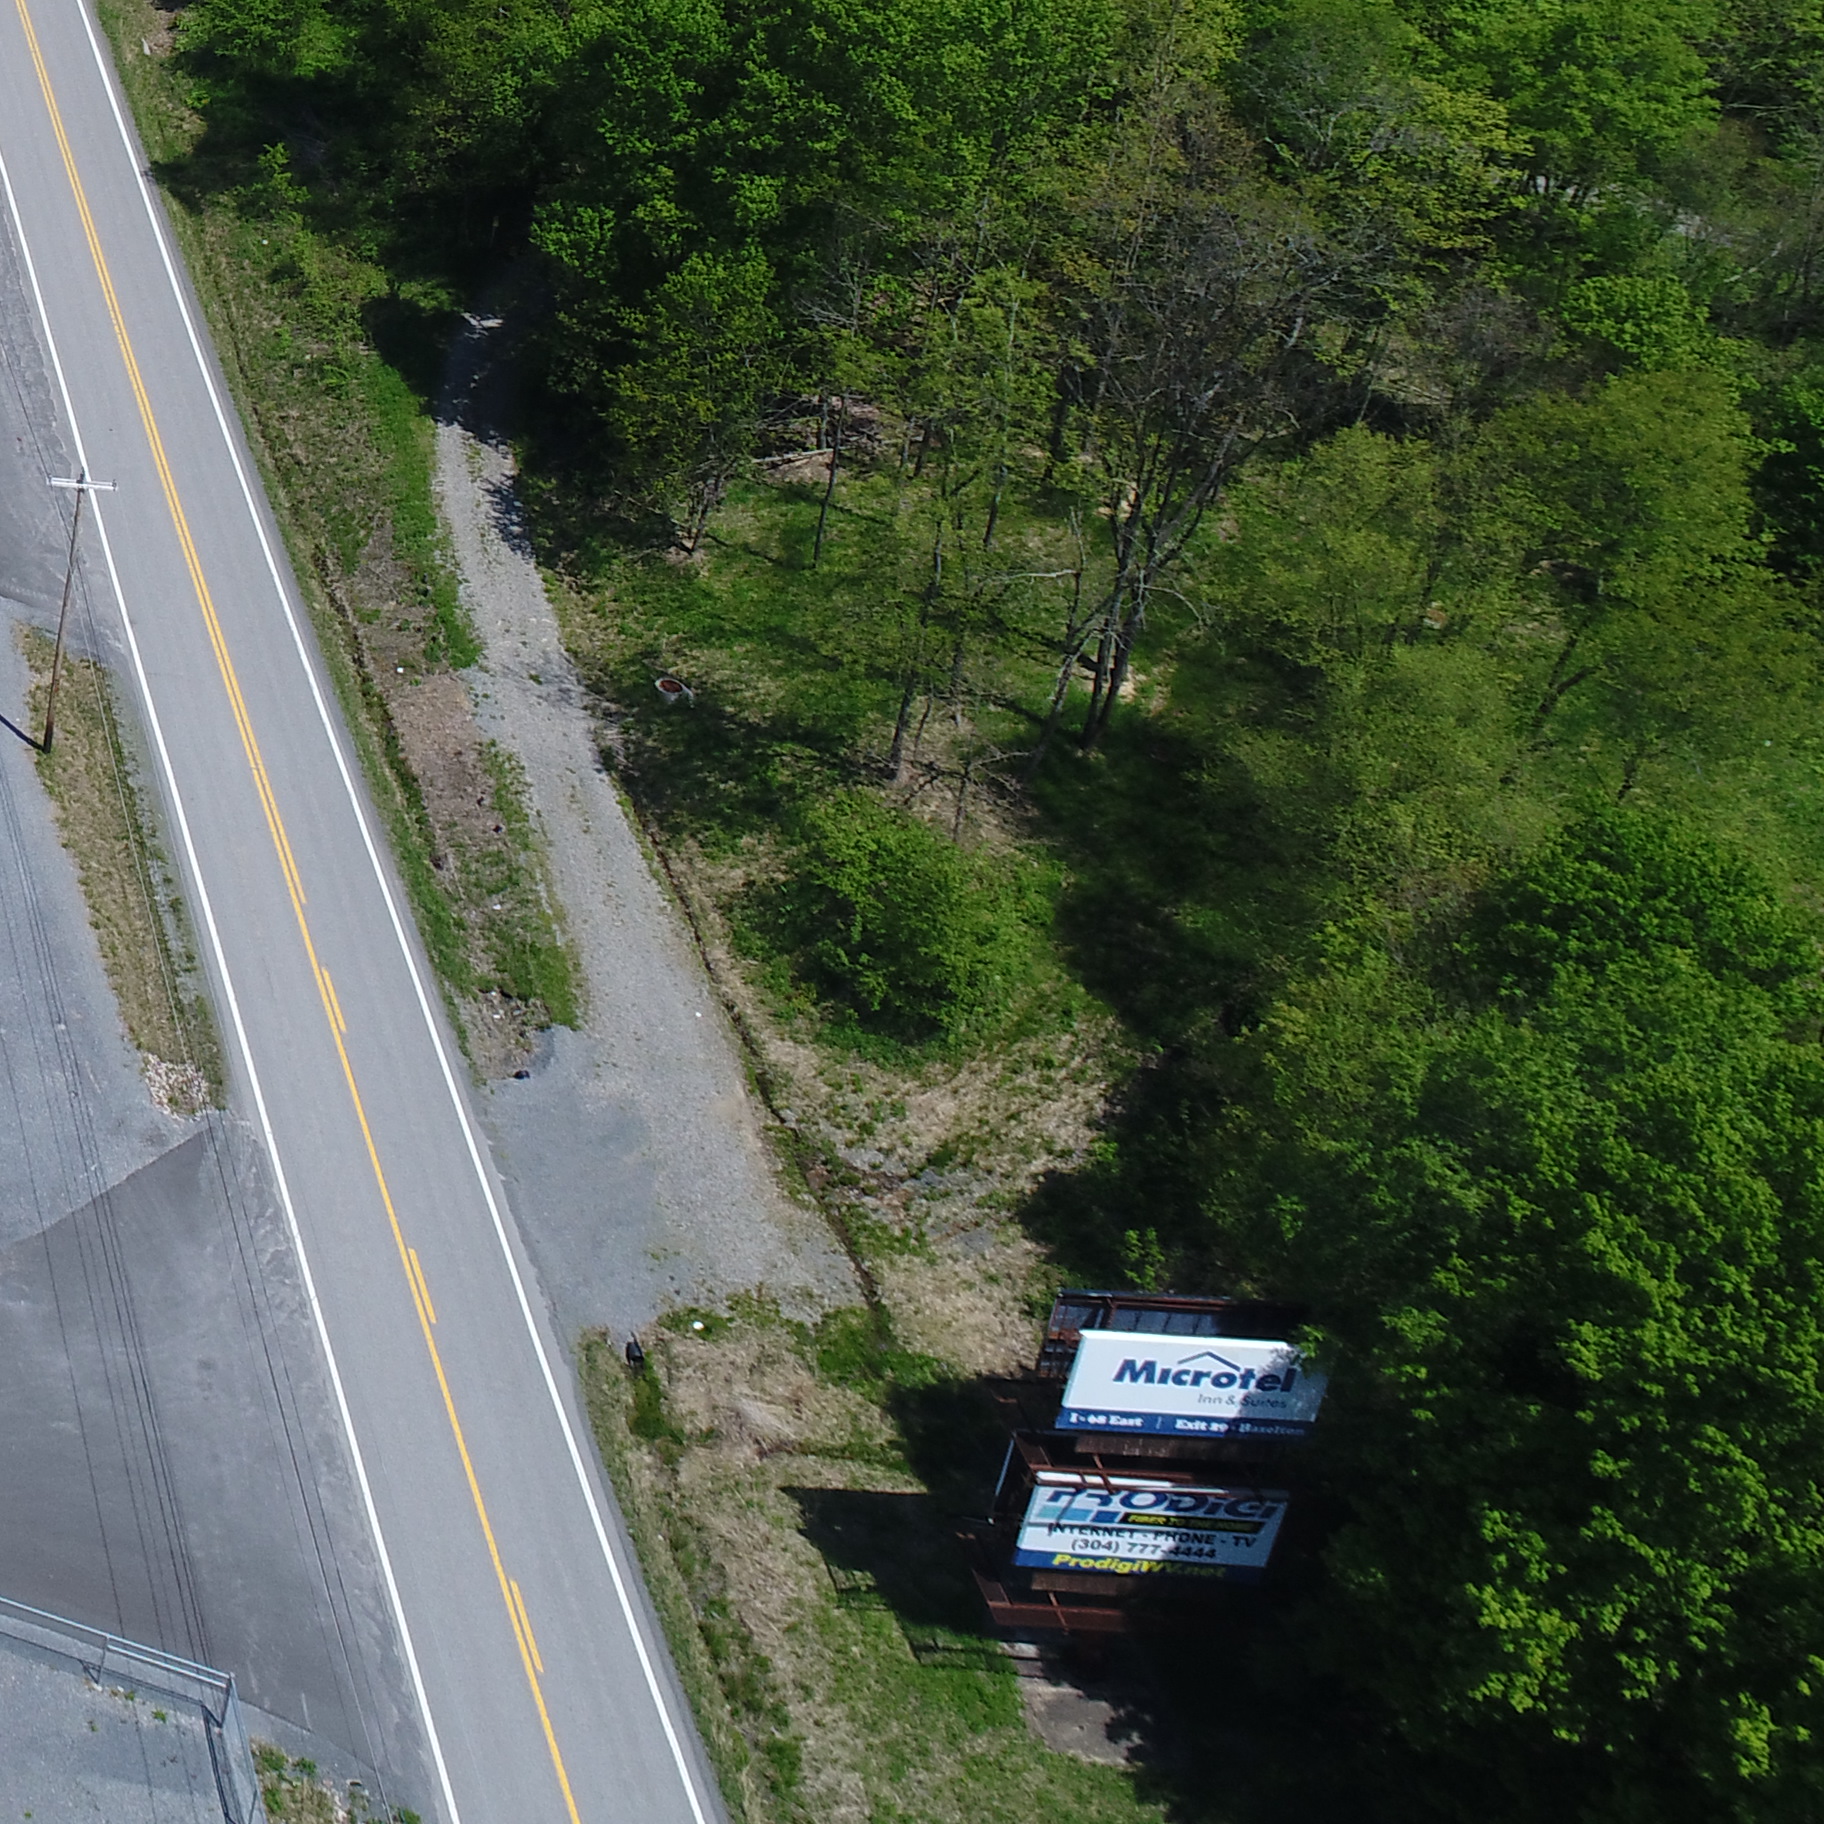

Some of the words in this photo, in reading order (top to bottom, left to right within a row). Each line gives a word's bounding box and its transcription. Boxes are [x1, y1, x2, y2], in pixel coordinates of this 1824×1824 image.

[1112, 1358, 1298, 1393] Microtel
[1197, 1393, 1224, 1405] Inn
[1226, 1395, 1235, 1406] &
[1239, 1394, 1288, 1409] Suites
[1109, 1413, 1144, 1428] East
[1174, 1417, 1206, 1431] Exit
[1151, 1530, 1217, 1545] PHONE
[1232, 1535, 1257, 1547] TV
[1070, 1538, 1120, 1554] (304)
[1127, 1541, 1217, 1559] 777-4444
